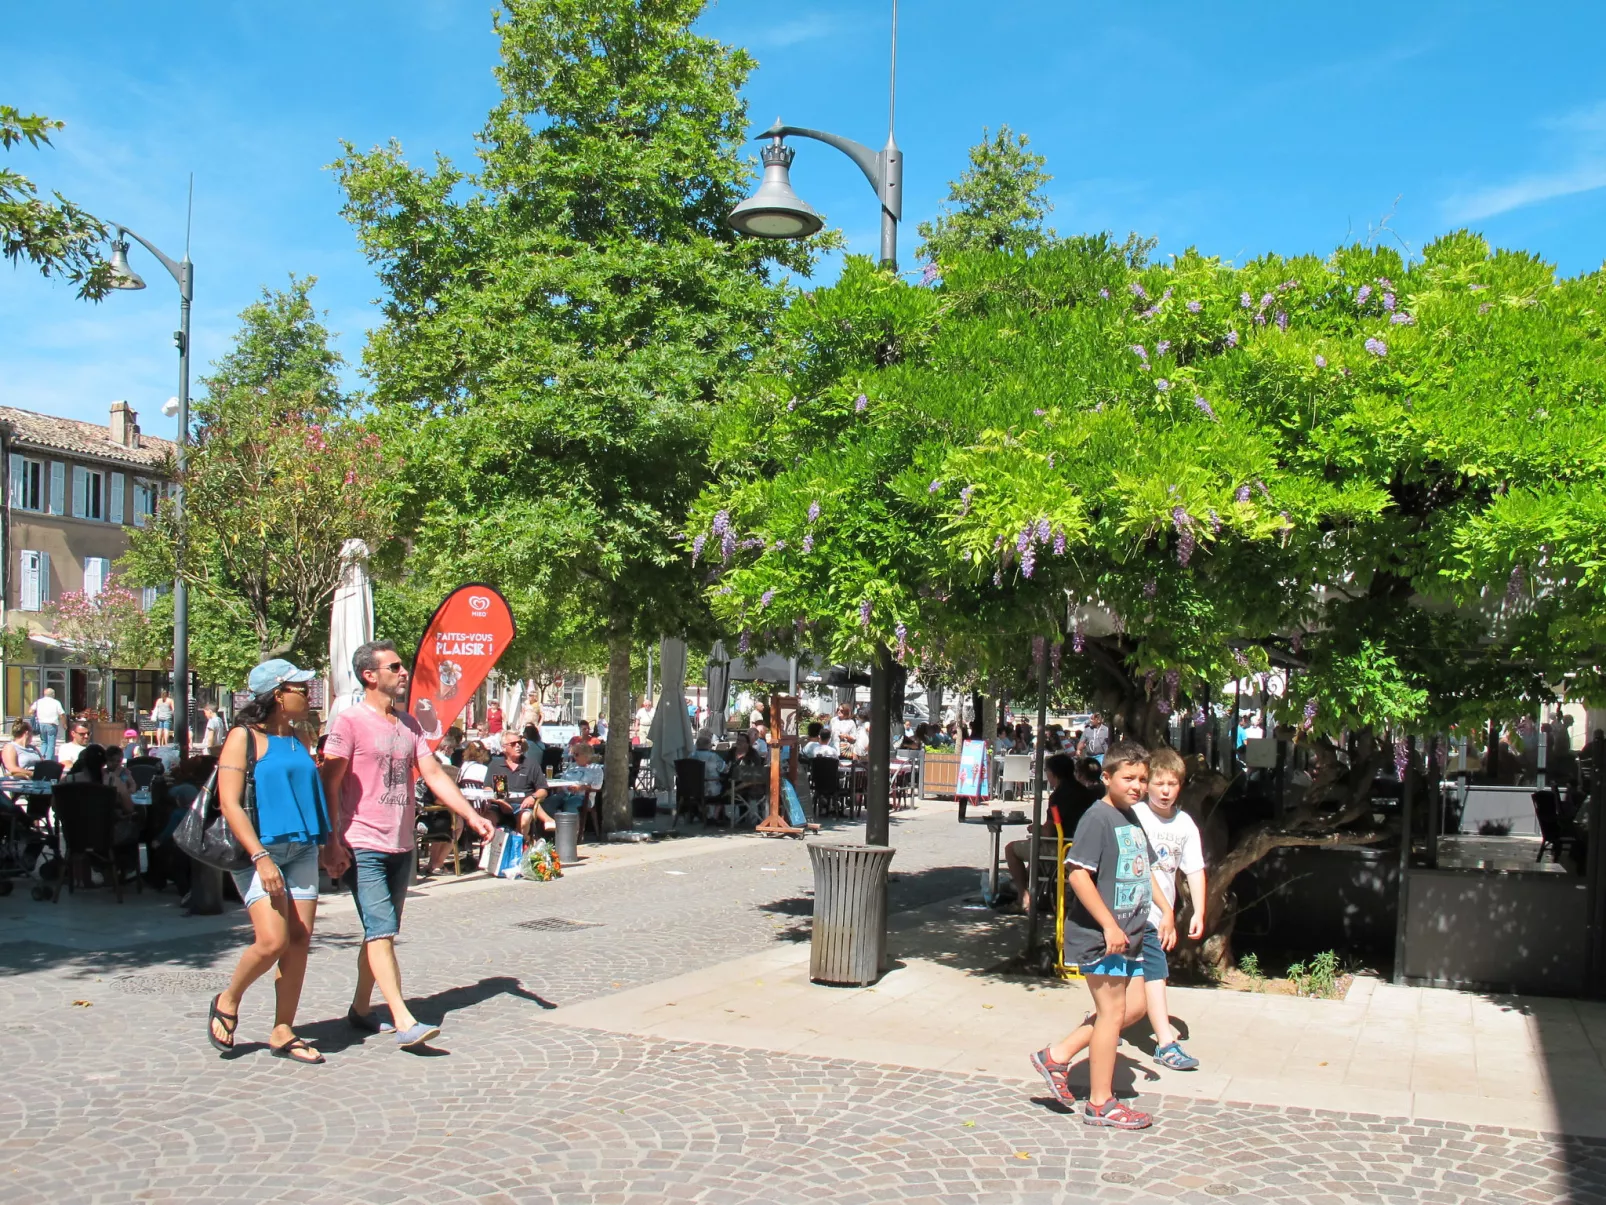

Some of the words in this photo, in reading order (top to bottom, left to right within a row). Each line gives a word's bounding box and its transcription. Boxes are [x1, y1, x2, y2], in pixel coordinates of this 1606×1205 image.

[436, 632, 494, 641] FAITES-VOUS
[436, 642, 485, 655] PLAISIR
[489, 643, 493, 654] !
